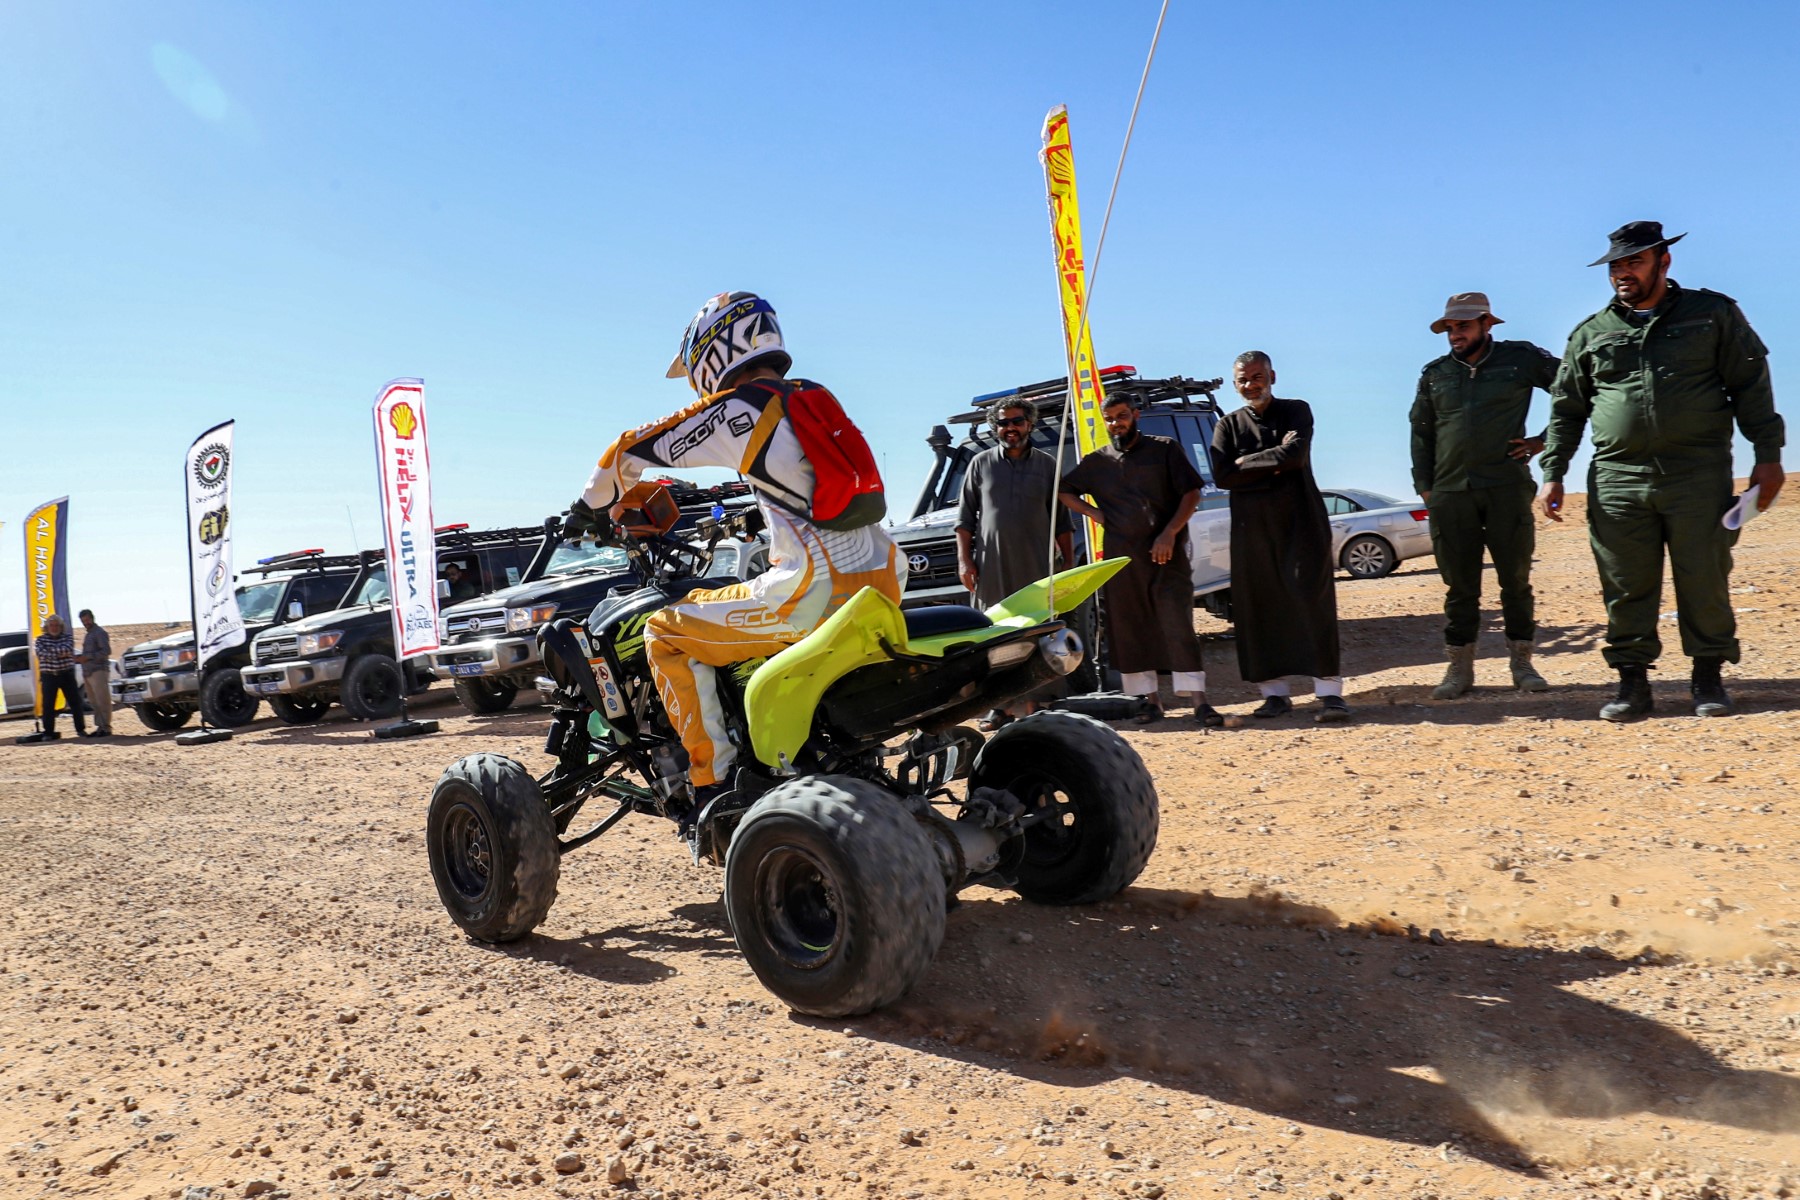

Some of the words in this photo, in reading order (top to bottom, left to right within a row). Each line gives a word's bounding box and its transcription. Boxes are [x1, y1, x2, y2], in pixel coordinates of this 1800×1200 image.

[669, 400, 728, 462] SCOTT
[35, 517, 50, 541] AL
[400, 530, 418, 600] ULTRA
